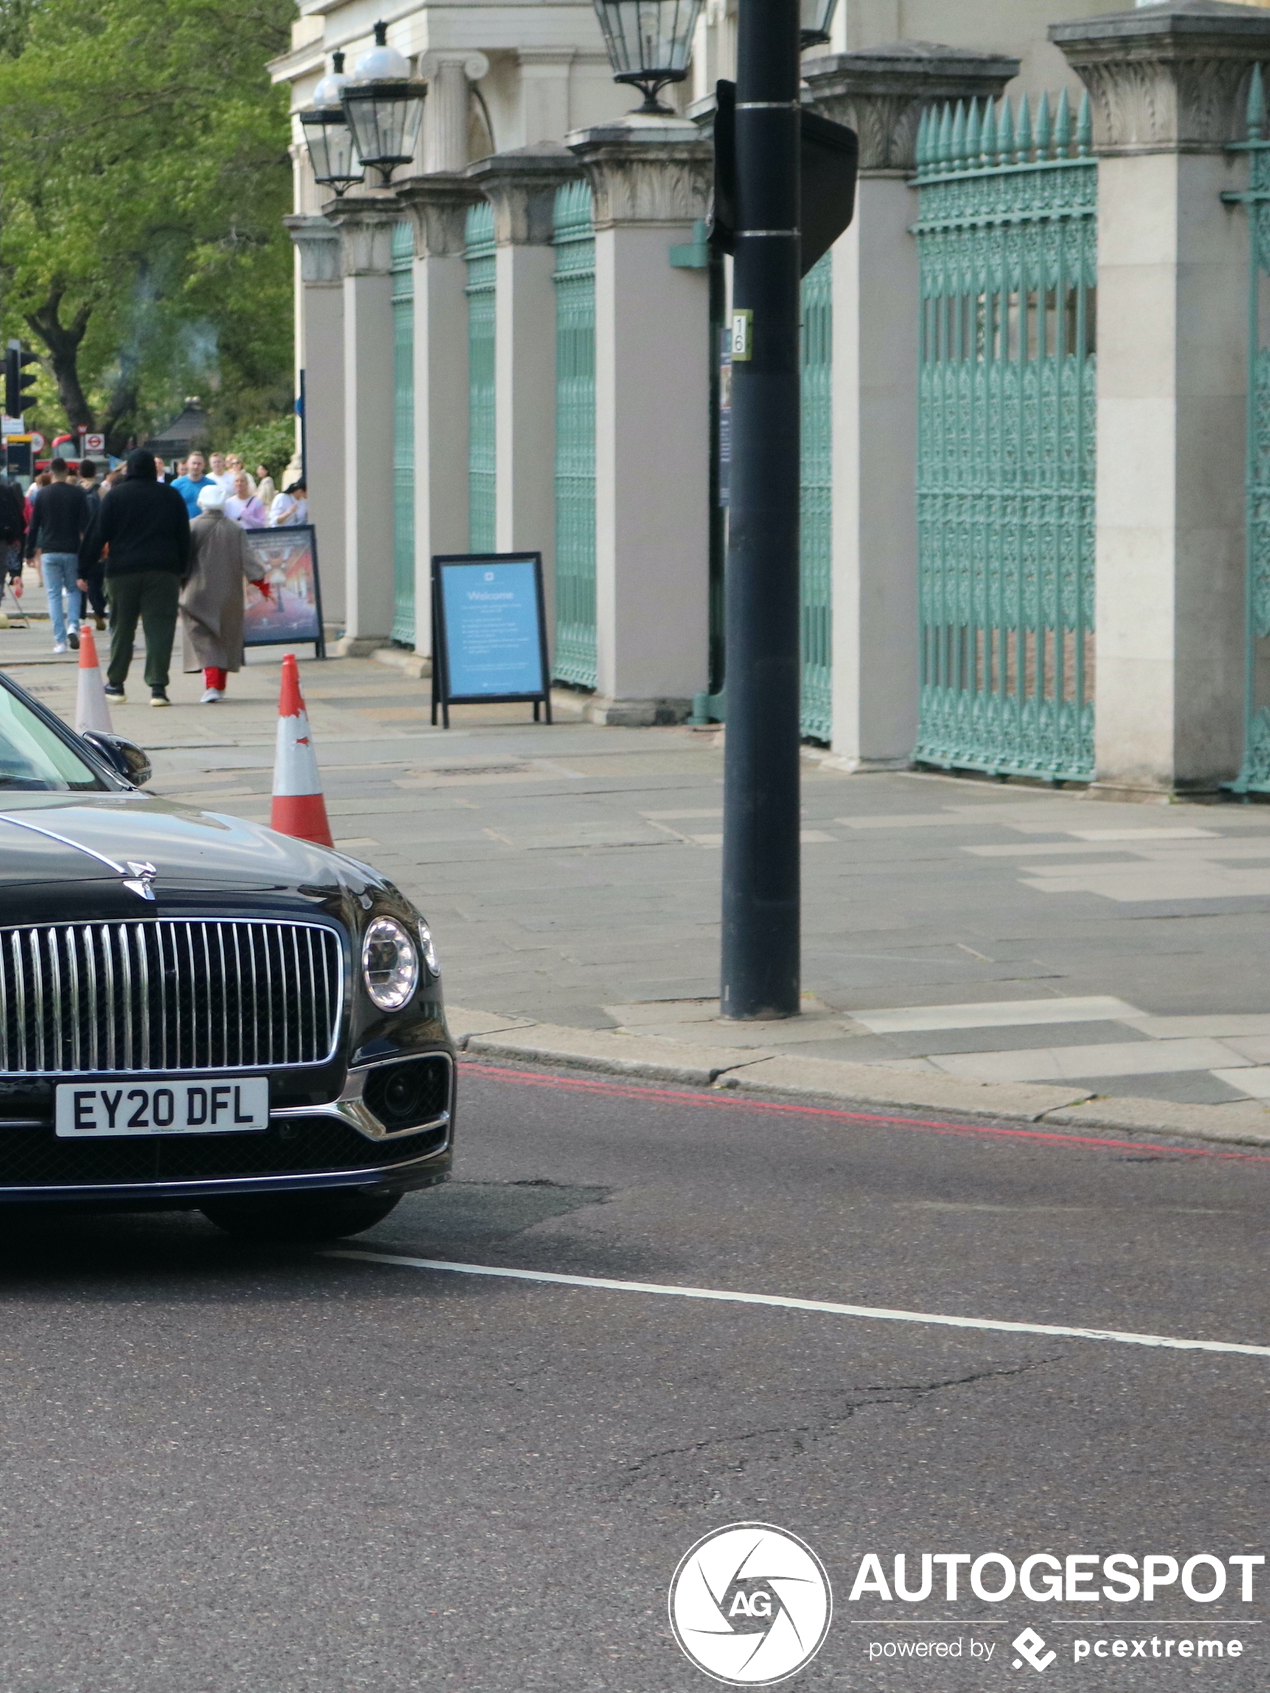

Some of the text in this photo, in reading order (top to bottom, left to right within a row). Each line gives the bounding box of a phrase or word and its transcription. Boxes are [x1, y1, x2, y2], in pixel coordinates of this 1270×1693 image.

[466, 591, 515, 601] Welcome
[74, 1086, 253, 1129] EY20 DFL
